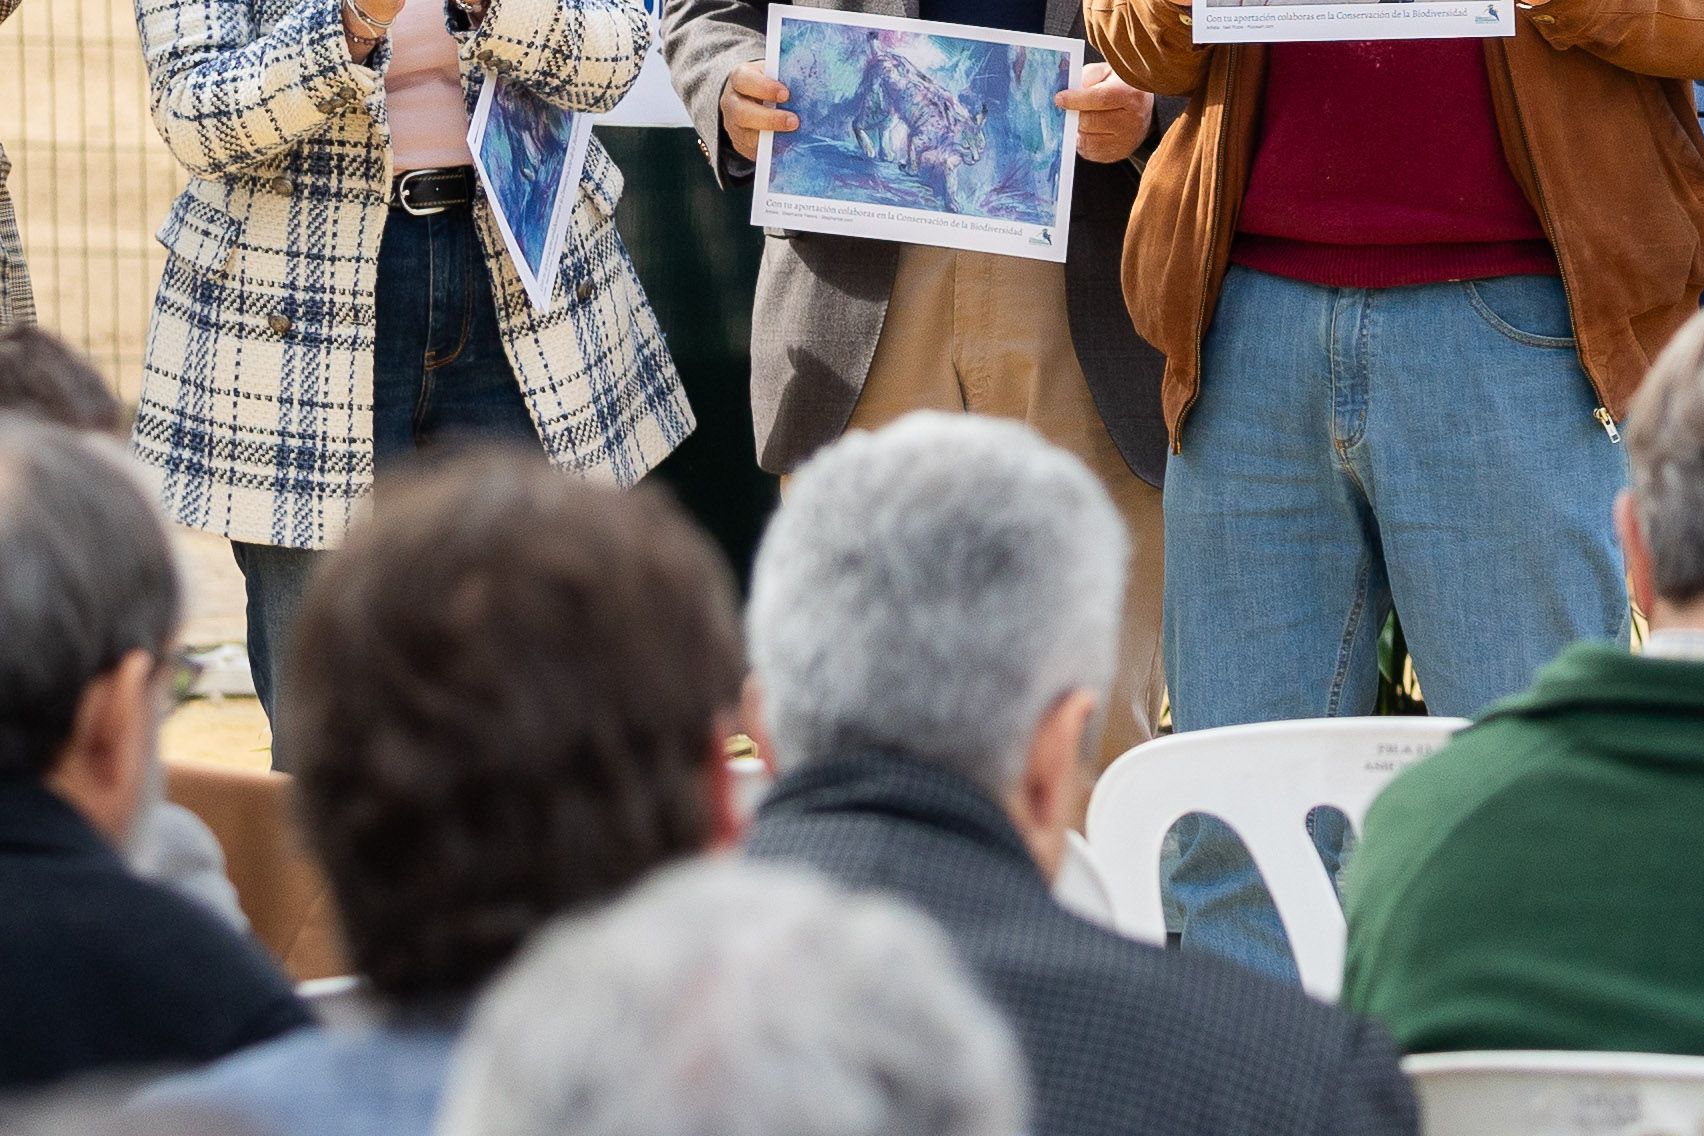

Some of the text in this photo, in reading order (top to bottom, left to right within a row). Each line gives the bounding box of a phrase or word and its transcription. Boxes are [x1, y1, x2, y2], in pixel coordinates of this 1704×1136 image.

[1206, 14, 1221, 23] Con
[1234, 13, 1276, 24] aportación
[1277, 12, 1315, 21] colaboras
[1328, 12, 1336, 20] la
[1336, 9, 1390, 20] Conservación
[1392, 9, 1401, 18] de
[1403, 9, 1411, 18] la
[1412, 7, 1468, 18] Biodiversidad
[766, 199, 781, 207] Con
[794, 202, 836, 214] aportación
[837, 207, 875, 218] colaboras
[876, 211, 887, 219] en
[888, 212, 895, 220] la
[896, 212, 949, 227] Conservación
[950, 219, 960, 228] de
[962, 219, 968, 229] la
[971, 222, 1023, 236] Biodiversidad
